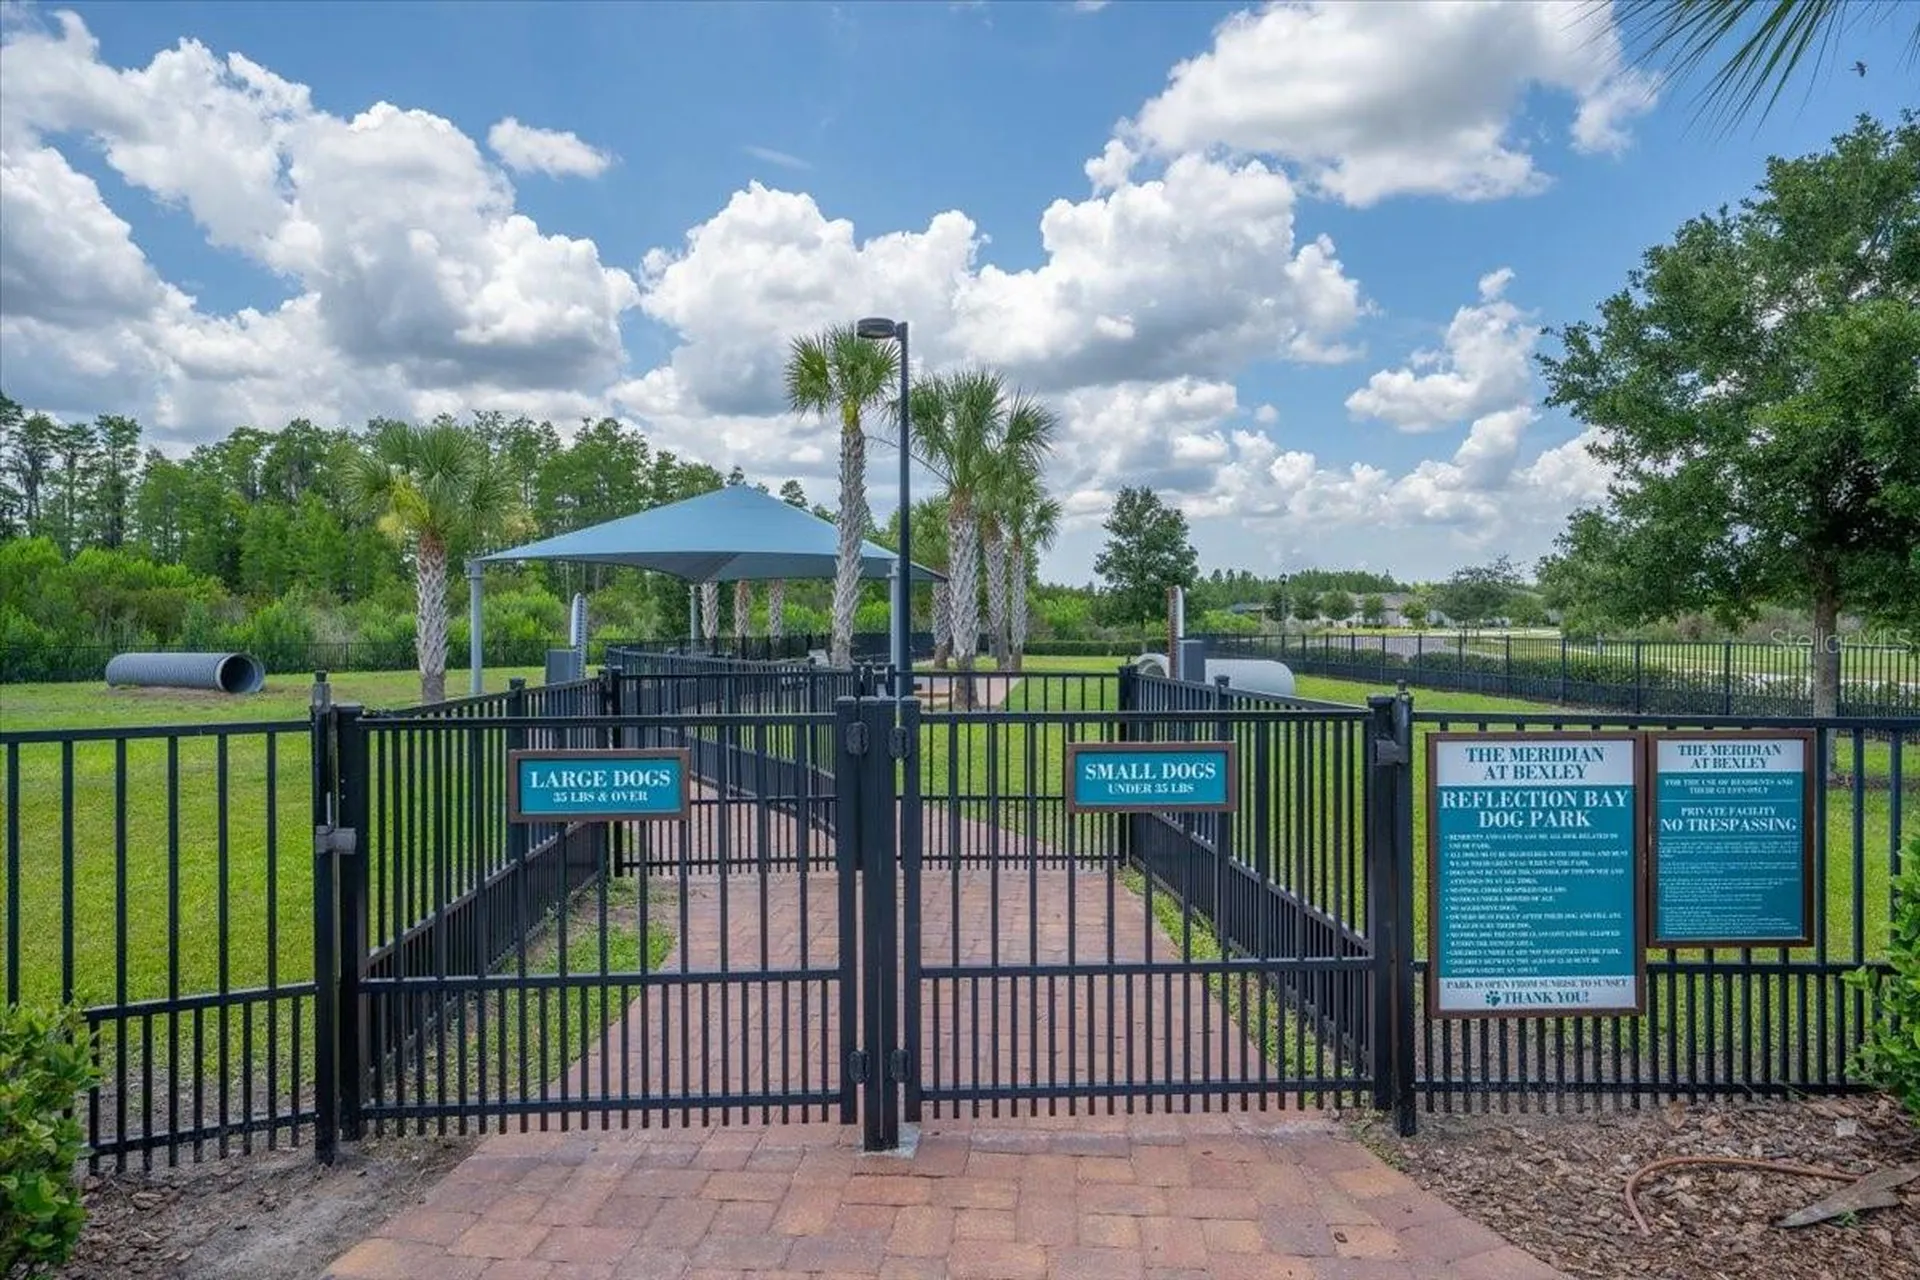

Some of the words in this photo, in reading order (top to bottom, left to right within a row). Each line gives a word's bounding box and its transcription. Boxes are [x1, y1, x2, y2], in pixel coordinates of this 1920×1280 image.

[1466, 747, 1505, 762] THE
[1508, 746, 1604, 762] MERIDIAN
[1678, 744, 1707, 756] THE
[1709, 744, 1782, 756] MERIDIAN
[1691, 757, 1709, 769] AT
[1713, 757, 1768, 769] BEXLEY
[1085, 762, 1156, 780] SMALL
[1162, 762, 1216, 779] DOGS
[1484, 765, 1509, 780] AT
[1513, 764, 1587, 780] BEXLEY
[529, 769, 607, 788] LARGE
[614, 769, 670, 787] DOGS
[1664, 778, 1681, 786] FOR
[1684, 778, 1700, 786] THE
[1718, 778, 1728, 786] OF
[1108, 783, 1152, 795] UNDER
[1154, 783, 1168, 794] 35
[1171, 783, 1194, 794] LBS
[553, 792, 567, 803] 35
[571, 792, 594, 802] LBS
[597, 791, 608, 802] &
[611, 791, 648, 801] OVER
[1441, 790, 1578, 808] REFLECTION
[1584, 790, 1628, 807] BAY
[1681, 807, 1728, 816] PRIVATE
[1729, 806, 1777, 816] FACILITY
[1479, 810, 1523, 828] DOG
[1530, 810, 1591, 827] PARK
[1660, 818, 1683, 832] NO
[1686, 817, 1797, 832] TRESPASSING
[1447, 979, 1473, 988] PARK
[1485, 979, 1510, 988] OPEN
[1512, 979, 1538, 988] FROM
[1579, 978, 1592, 987] TO
[1502, 991, 1553, 1004] THANK
[1556, 991, 1589, 1003] YOU!
